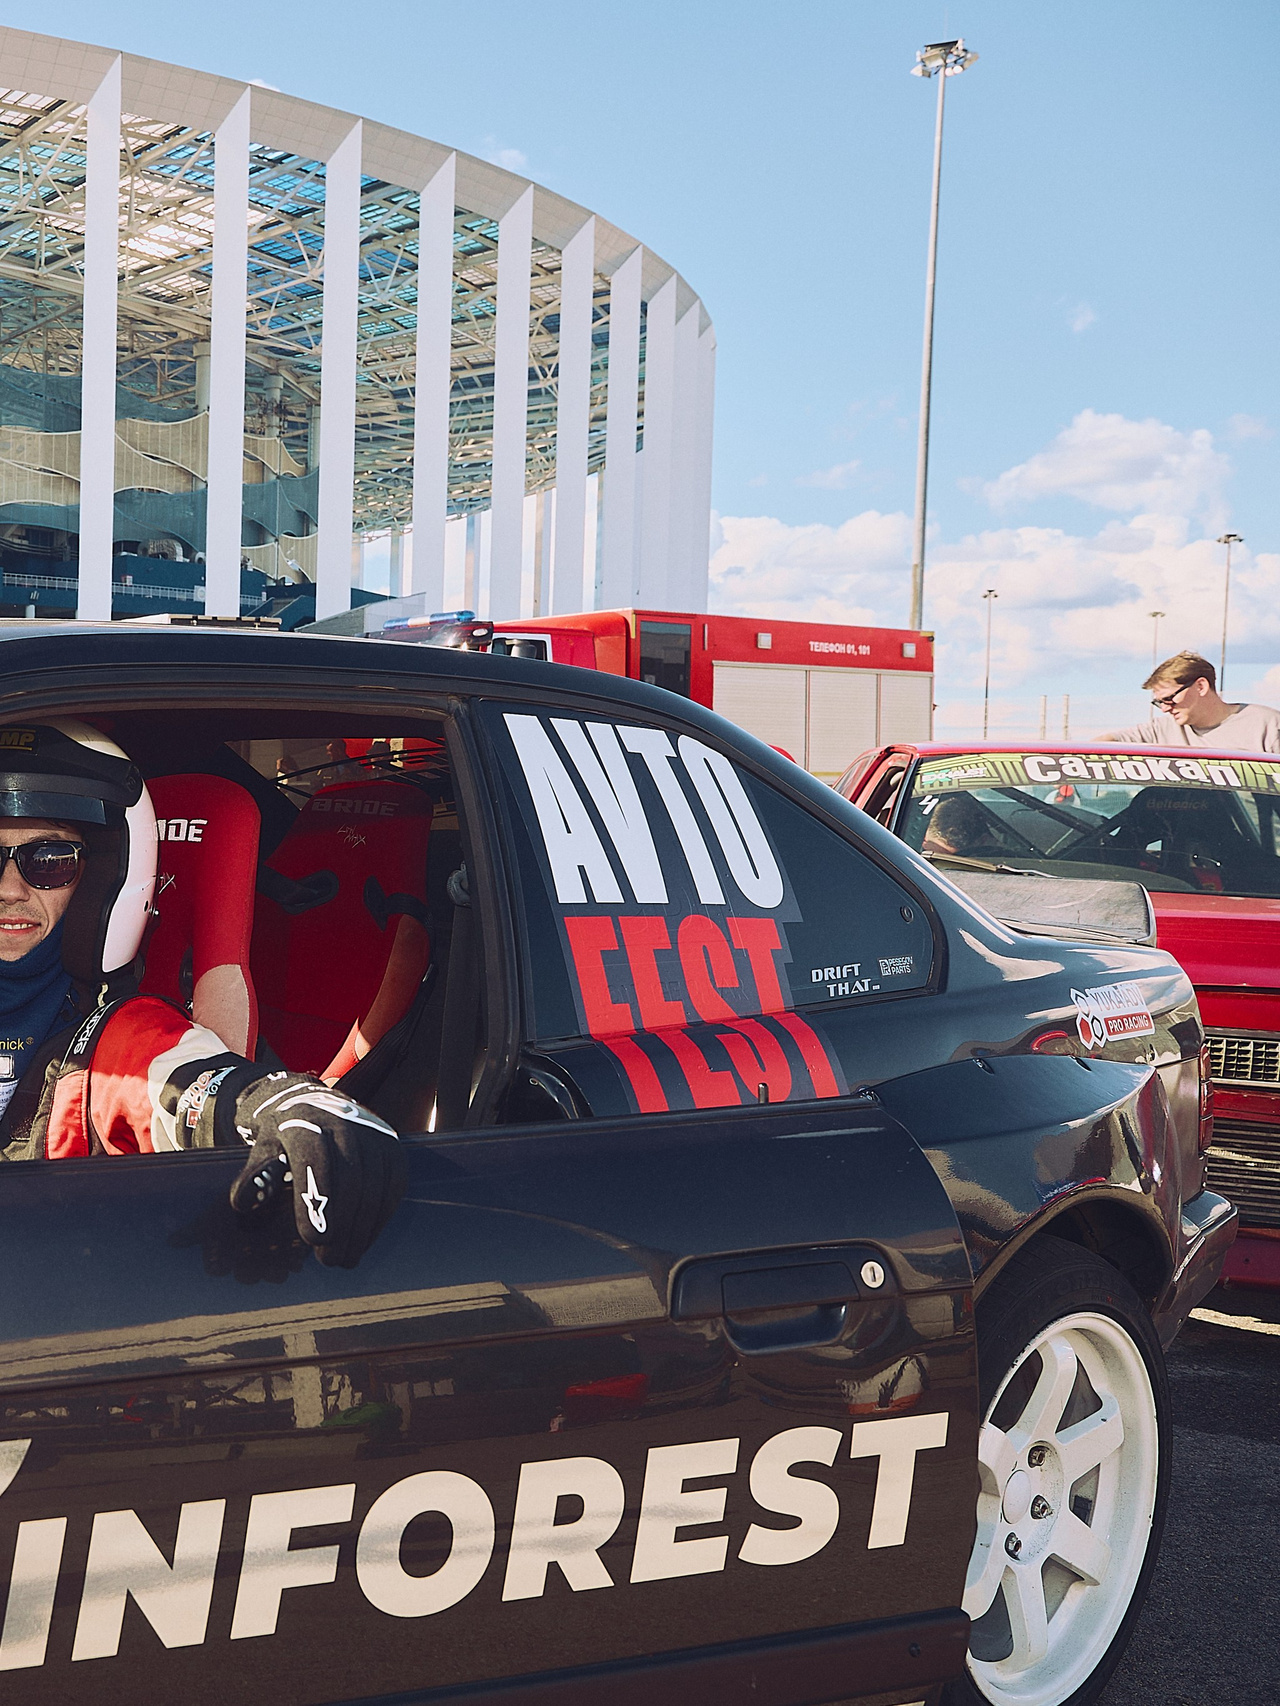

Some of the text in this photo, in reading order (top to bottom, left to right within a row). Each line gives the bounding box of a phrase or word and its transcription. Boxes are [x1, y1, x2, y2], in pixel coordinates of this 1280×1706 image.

[809, 641, 846, 654] ТЕЛЕФОН
[311, 798, 400, 817] BRIDE
[502, 712, 785, 909] AVTO
[154, 818, 208, 843] IDE
[811, 963, 861, 983] DRIFT
[891, 965, 912, 975] PARTS
[1107, 1015, 1149, 1033] PRO RACING
